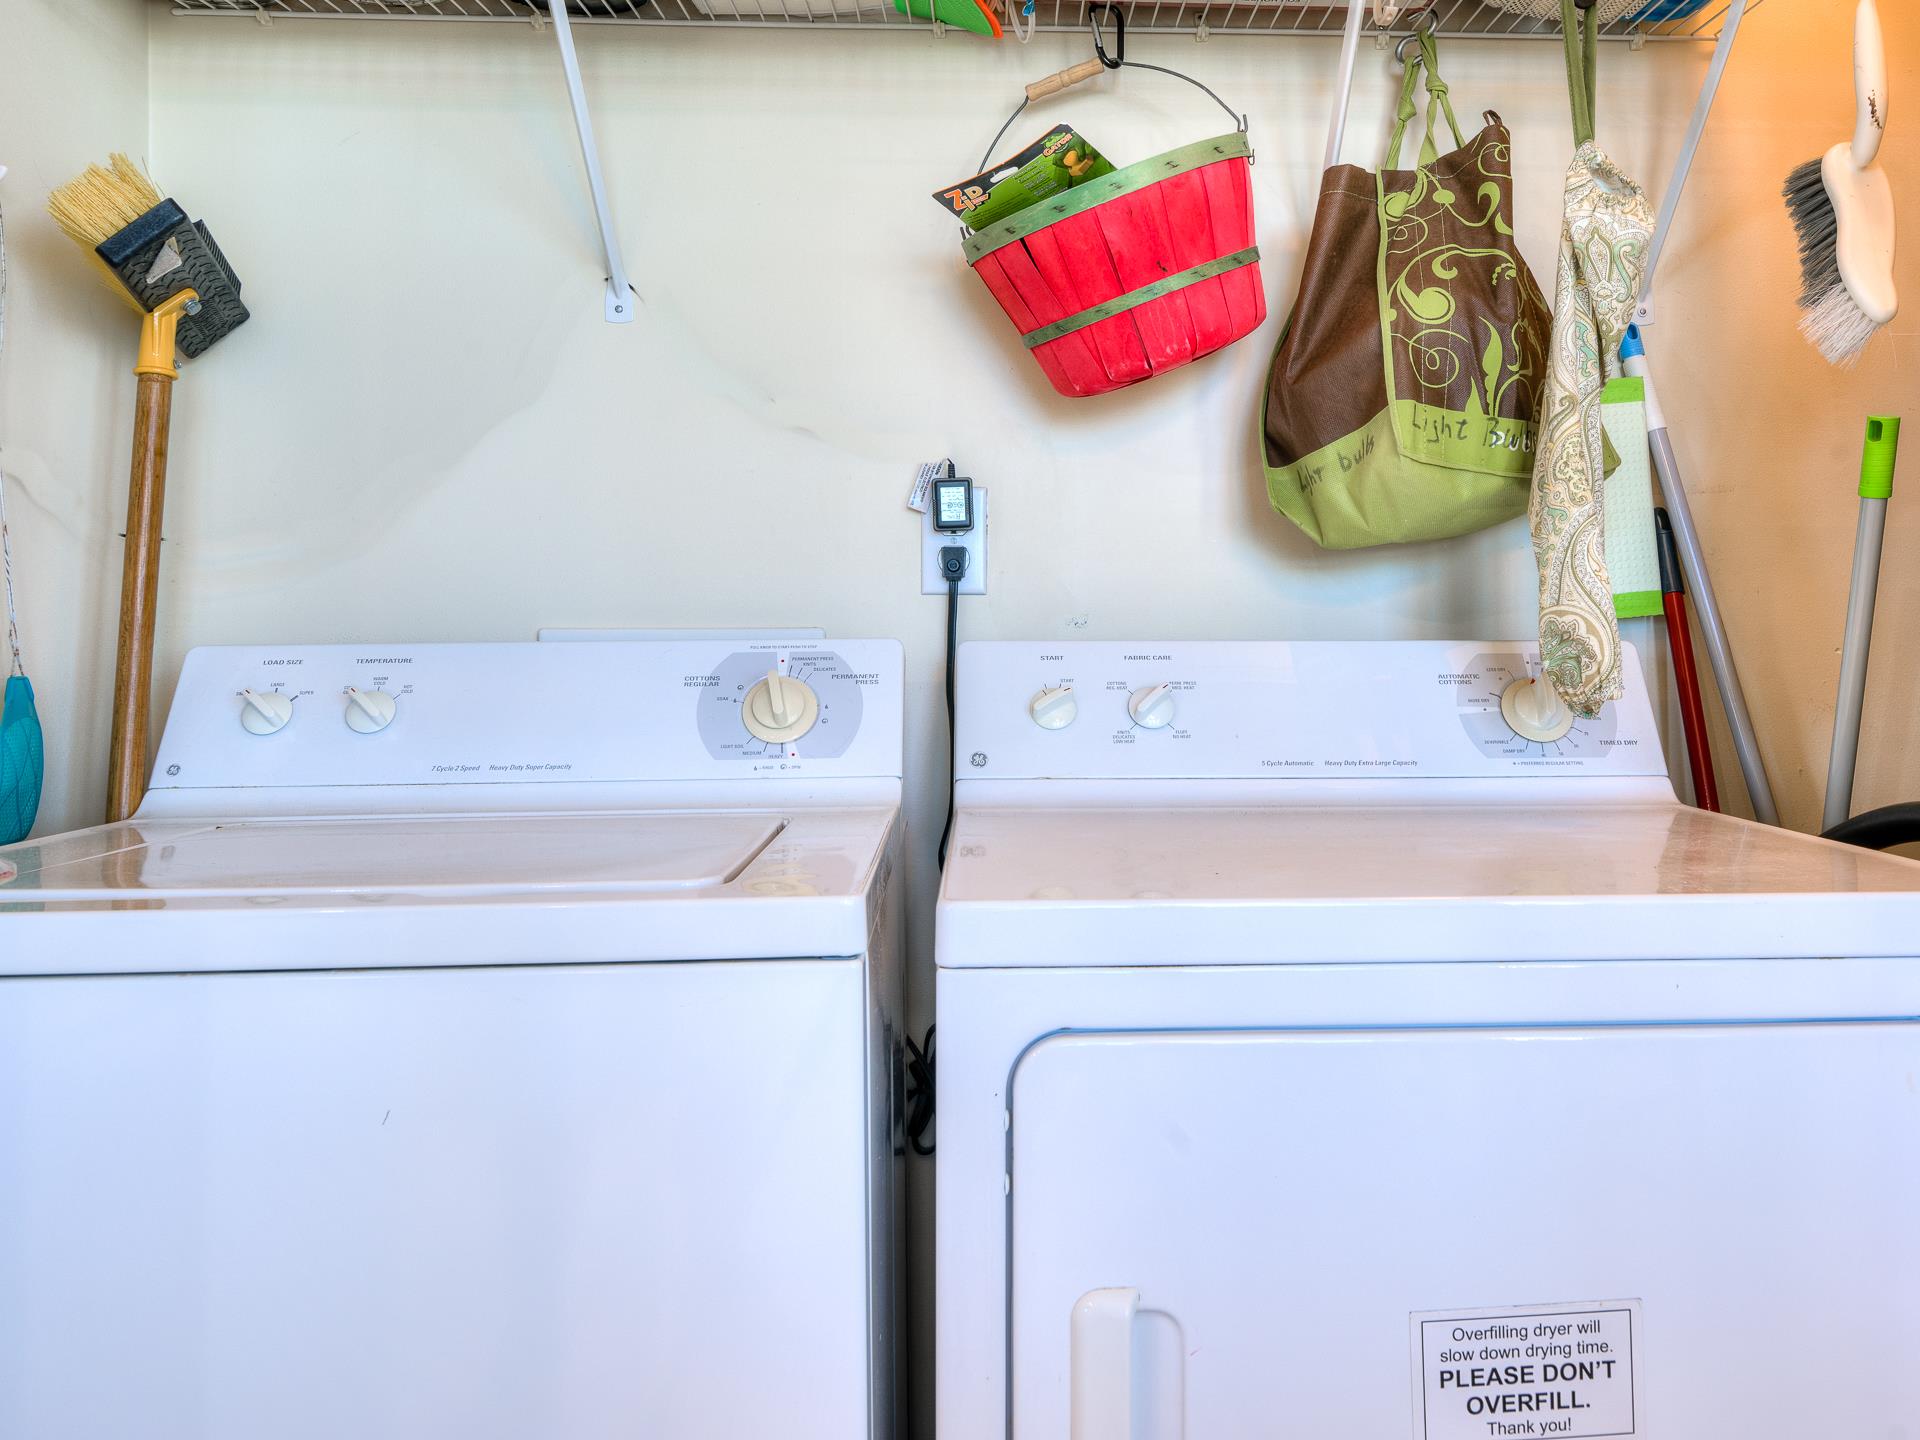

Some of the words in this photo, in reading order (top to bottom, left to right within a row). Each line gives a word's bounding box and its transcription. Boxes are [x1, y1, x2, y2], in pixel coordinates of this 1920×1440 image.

[1412, 403, 1468, 443] Light
[1452, 1325, 1528, 1342] Overfilling
[1534, 1323, 1573, 1340] dryer
[1577, 1320, 1600, 1334] will
[1440, 1348, 1474, 1362] slow
[1480, 1346, 1520, 1360] down
[1526, 1343, 1572, 1360] drying
[1576, 1341, 1613, 1354] time.
[1440, 1366, 1534, 1388] PLEASE
[1542, 1360, 1616, 1382] DON'T
[1466, 1390, 1590, 1415] OVERFILL.
[1487, 1420, 1534, 1436] Thank
[1539, 1418, 1572, 1434] you!
